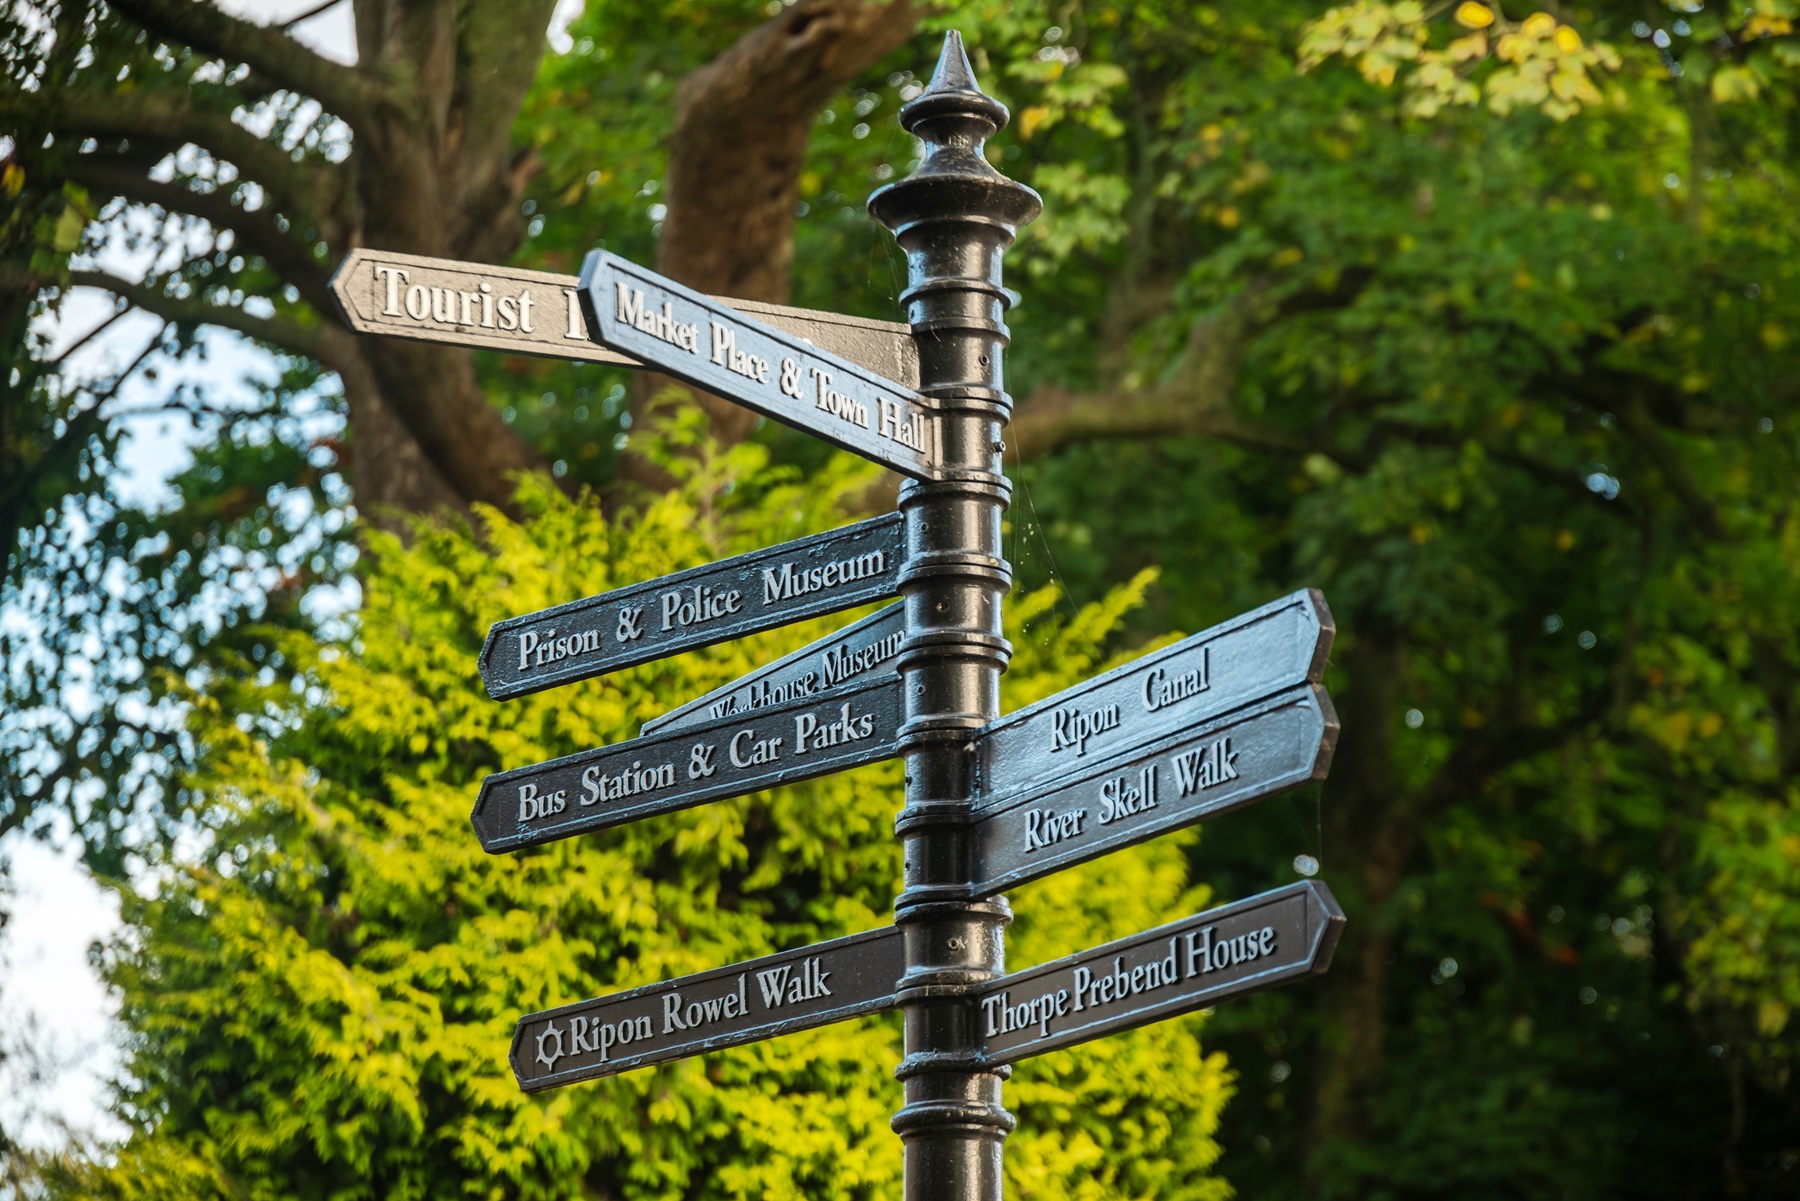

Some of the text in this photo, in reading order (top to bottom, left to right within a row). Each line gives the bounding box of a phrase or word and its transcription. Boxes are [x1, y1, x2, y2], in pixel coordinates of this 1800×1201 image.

[374, 265, 535, 334] Tourist
[615, 281, 699, 354] Market
[711, 321, 769, 385] Place
[781, 357, 804, 400] &
[811, 367, 869, 429] Town
[877, 396, 926, 454] Hall
[518, 549, 886, 671] Prison & Police Museum
[822, 629, 906, 689] Museum
[1050, 647, 1210, 757] Ripon Canal
[518, 703, 875, 823] Bus Station & Car Parks
[1024, 737, 1240, 853] River Skell Walk
[569, 957, 833, 1061] Ripon Rowel Walk
[981, 925, 1276, 1038] Thorpe Prebend House
